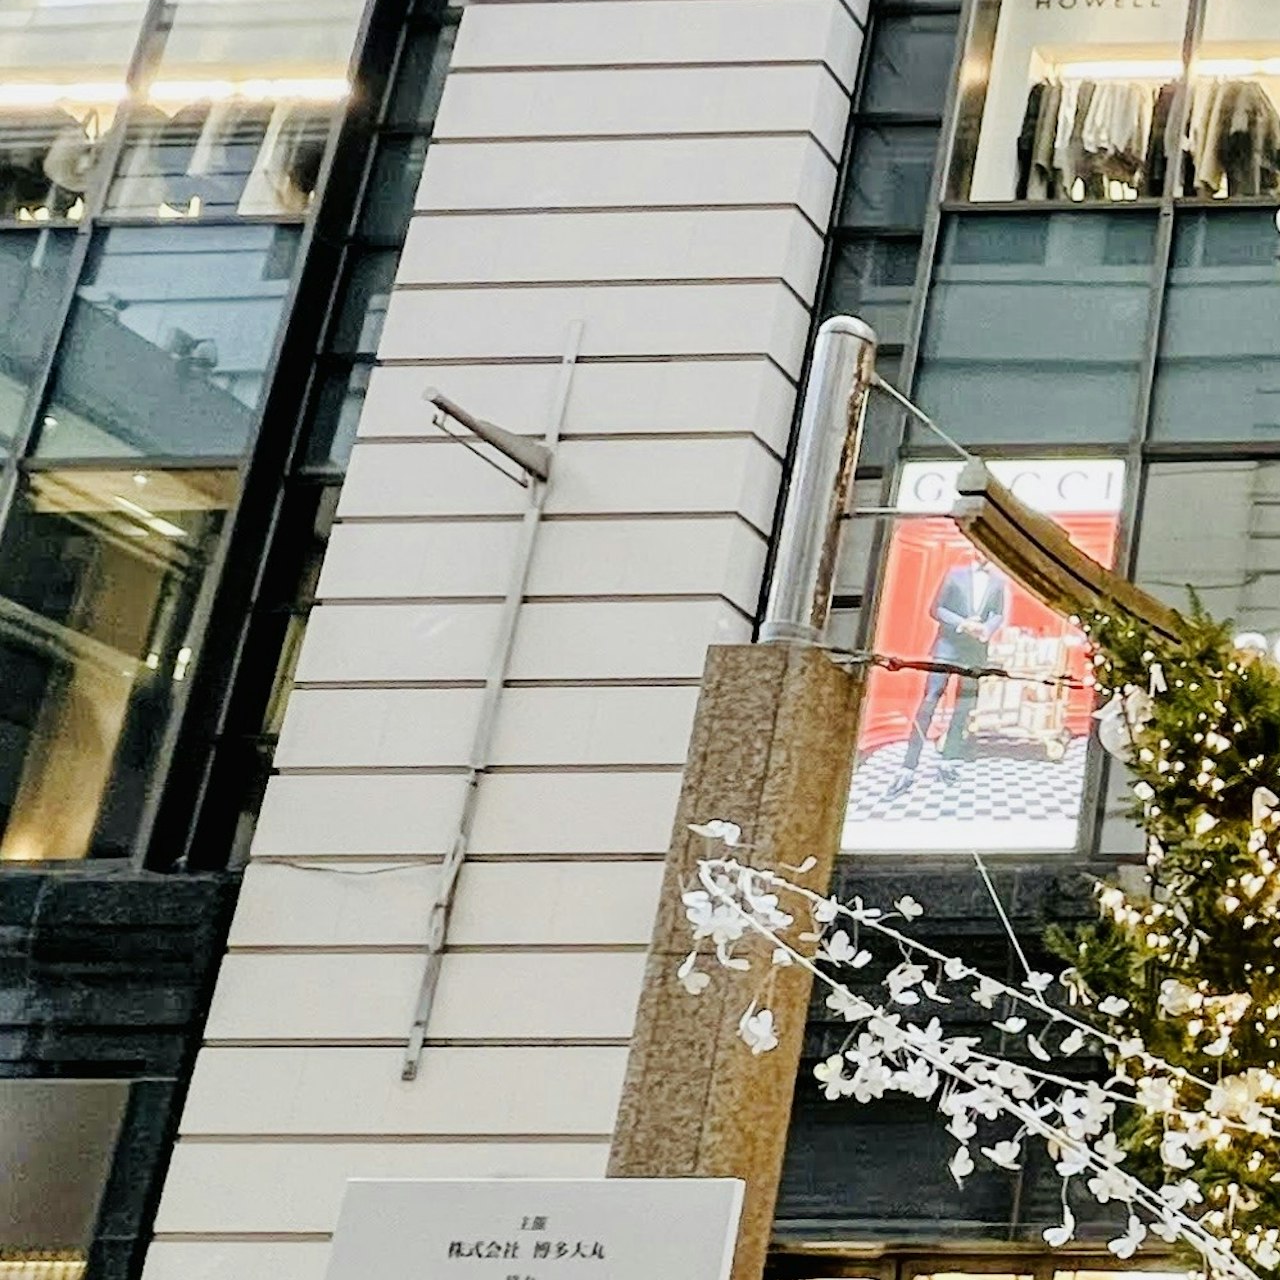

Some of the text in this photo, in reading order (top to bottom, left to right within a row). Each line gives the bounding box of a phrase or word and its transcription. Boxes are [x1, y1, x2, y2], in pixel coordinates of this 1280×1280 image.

[913, 470, 1114, 503] GCCI
[448, 1240, 606, 1260] 株式会社 博多大丸
